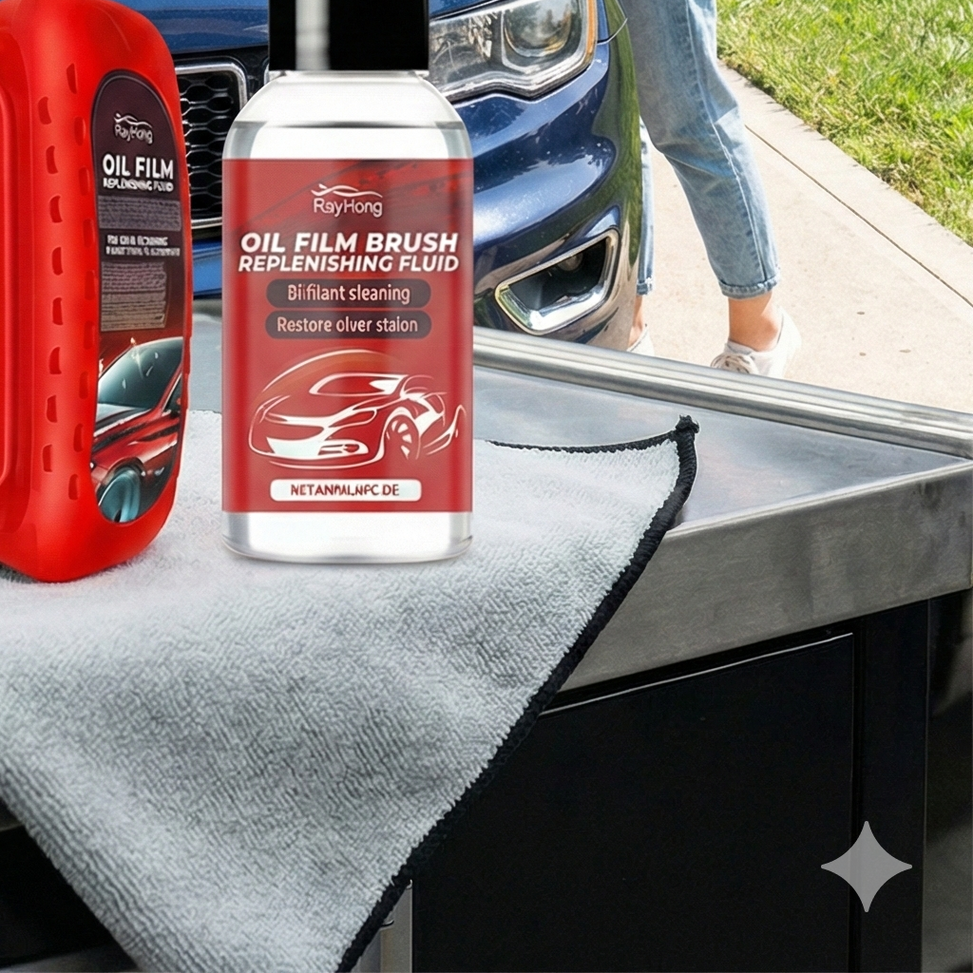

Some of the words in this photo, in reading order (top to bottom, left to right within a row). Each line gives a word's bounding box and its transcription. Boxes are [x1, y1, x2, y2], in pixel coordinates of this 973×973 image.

[102, 153, 131, 177] OIL
[135, 156, 174, 180] FILM
[313, 198, 383, 218] RayHong
[240, 232, 286, 253] OIL
[294, 232, 358, 253] FILM
[365, 232, 459, 253] BRUSH
[238, 255, 393, 272] REPLENISHING
[398, 255, 459, 272] FLUID
[349, 284, 411, 305] sleaning
[277, 316, 333, 333] Restore
